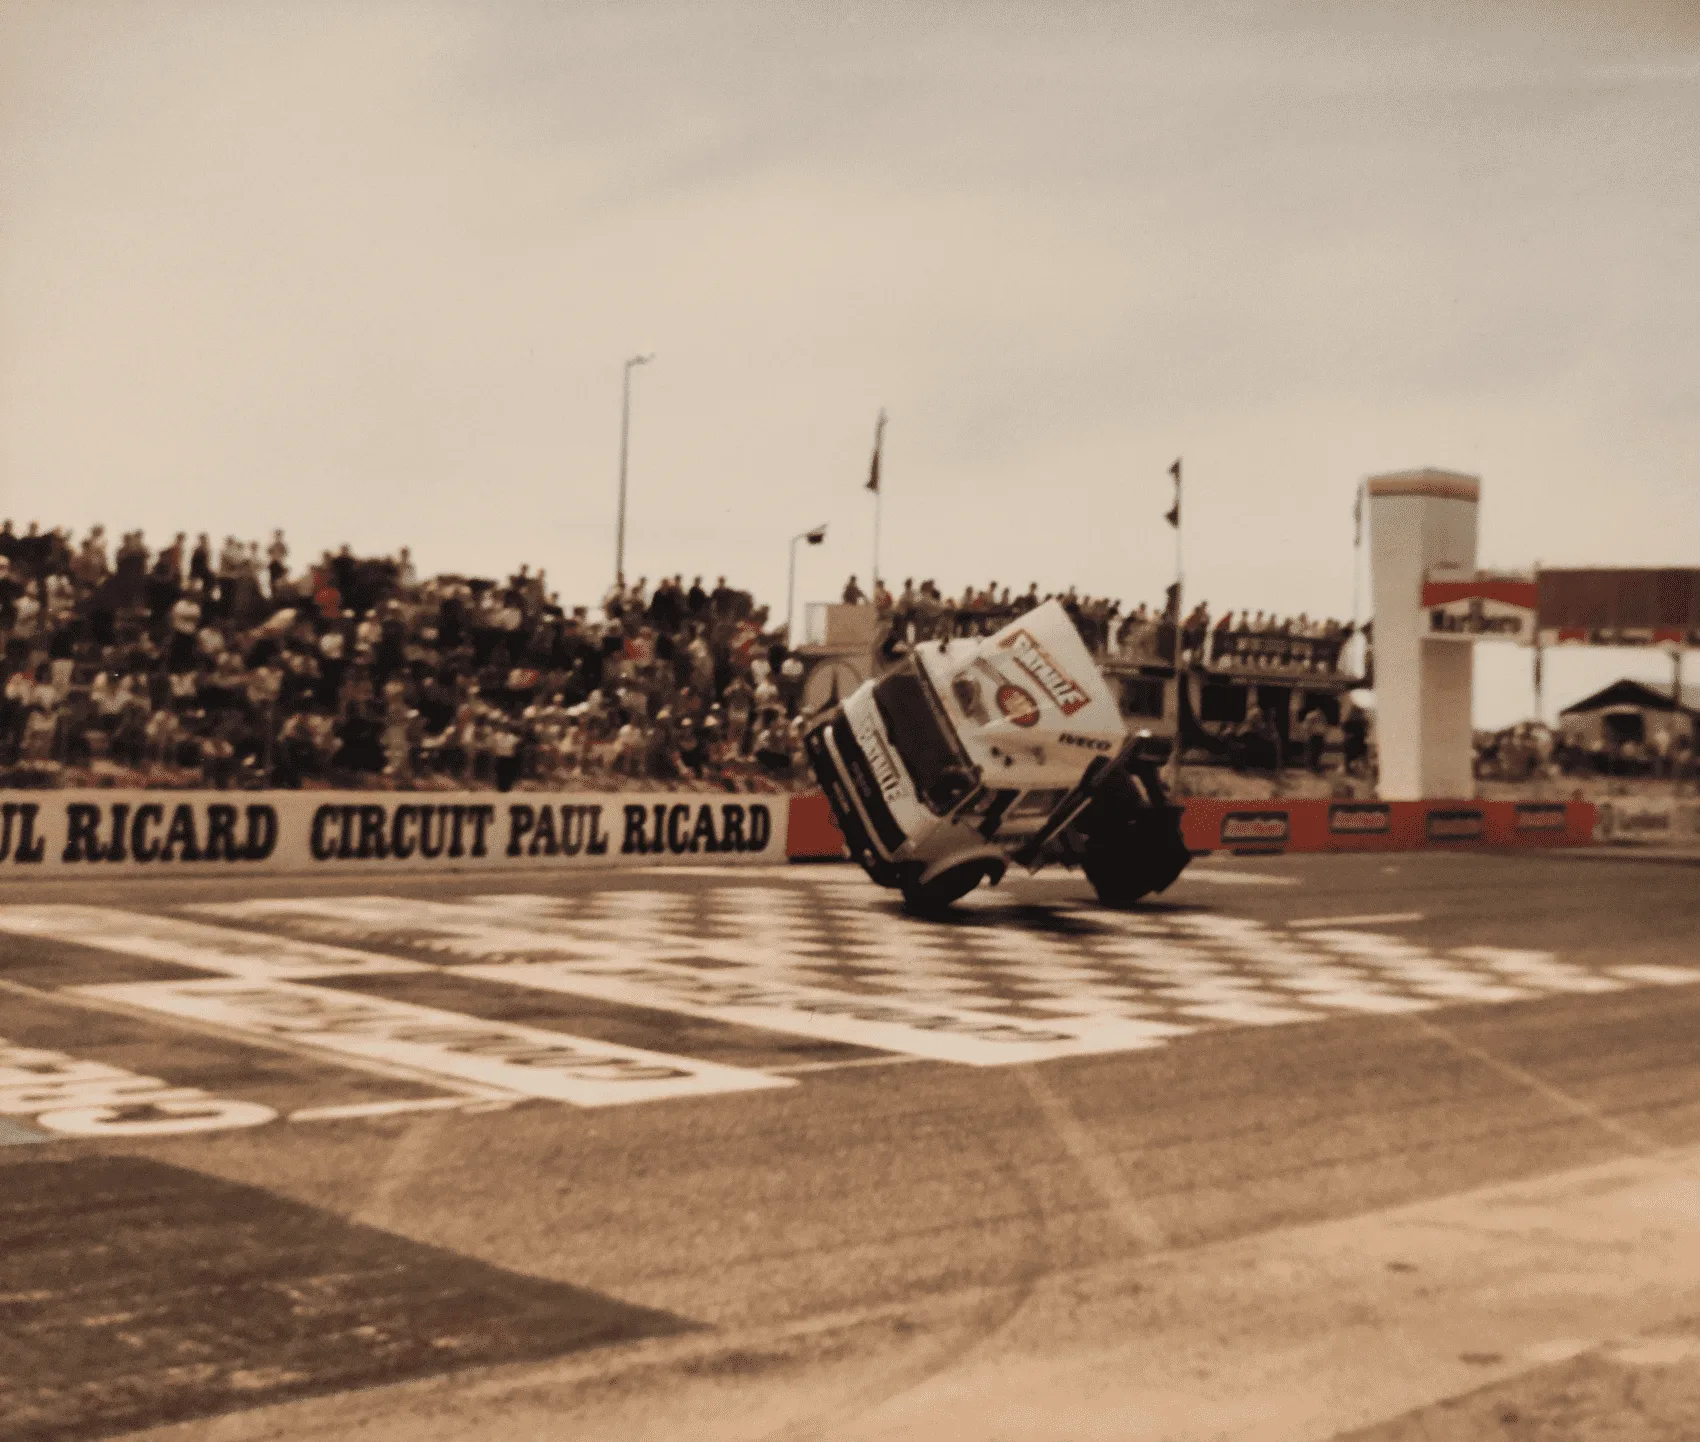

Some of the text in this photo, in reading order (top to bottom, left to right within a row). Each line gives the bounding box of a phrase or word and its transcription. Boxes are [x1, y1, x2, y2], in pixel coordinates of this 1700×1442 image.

[1058, 732, 1112, 752] IVECO
[61, 802, 279, 863] RICARD
[310, 803, 494, 861] CIRCUIT
[507, 803, 609, 857] PAUL
[620, 803, 772, 855] RICARD
